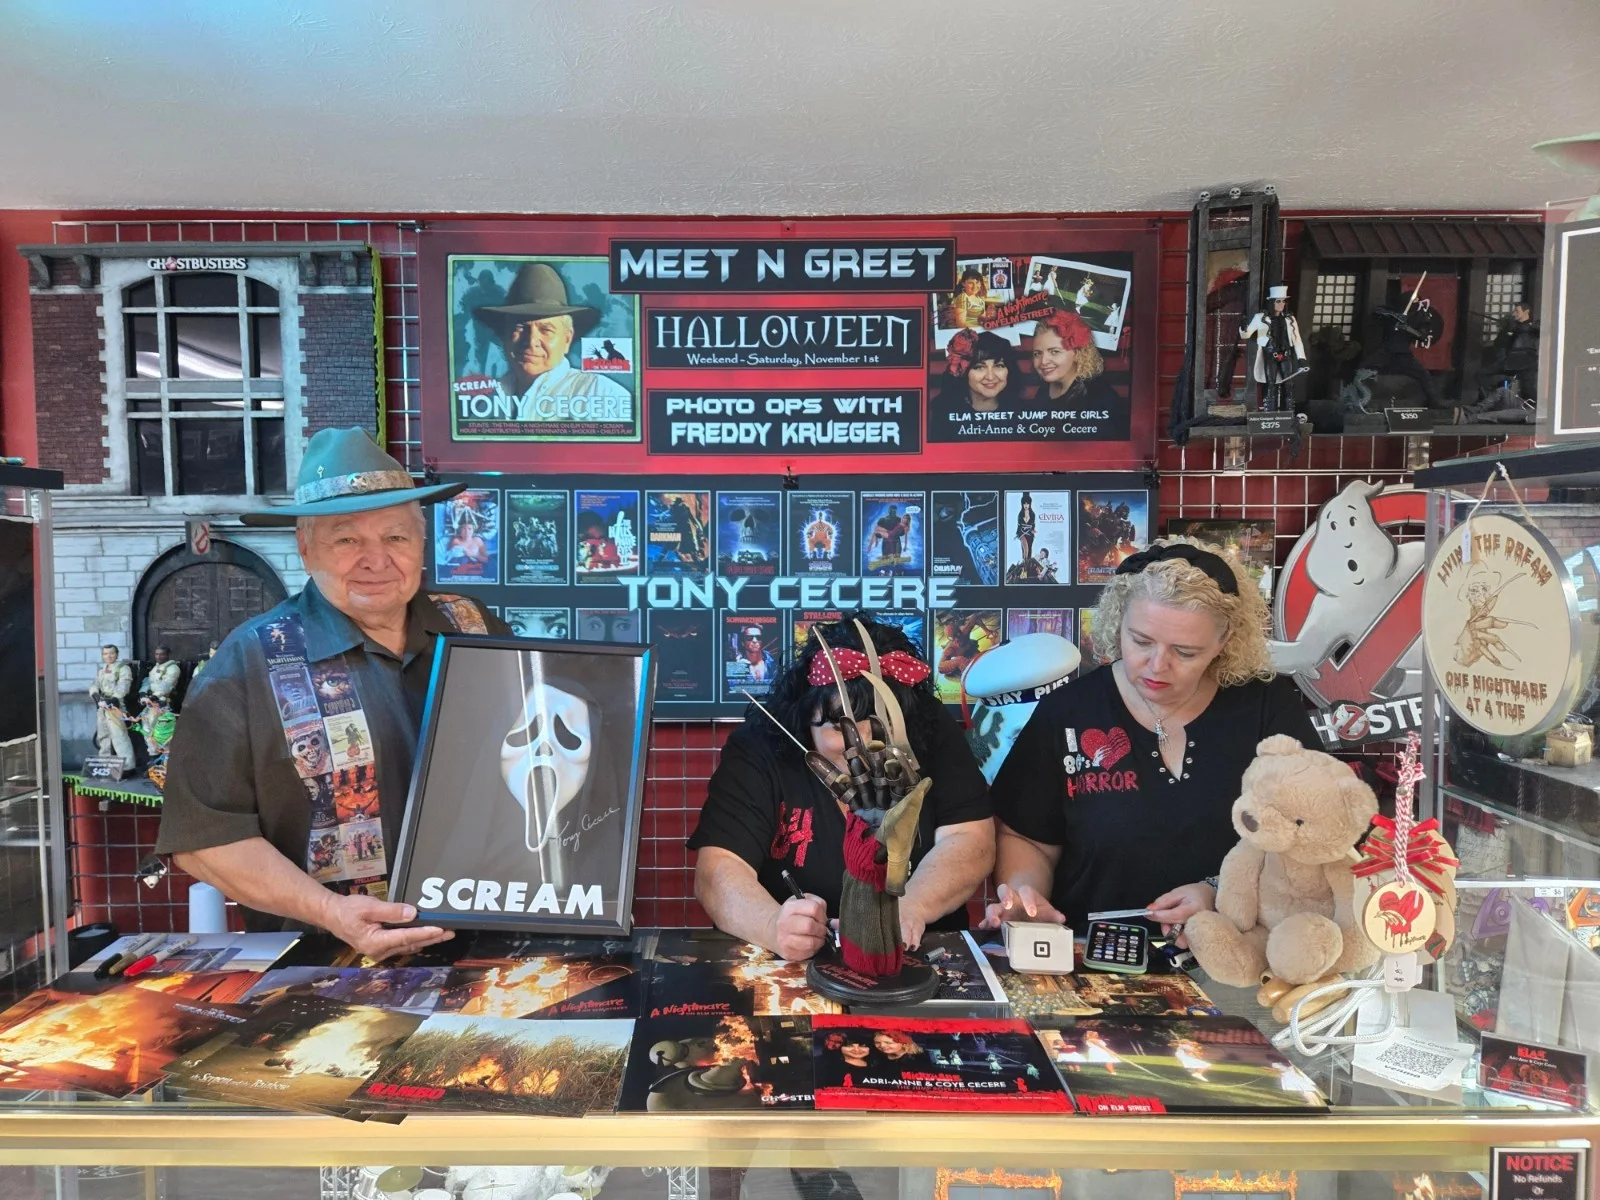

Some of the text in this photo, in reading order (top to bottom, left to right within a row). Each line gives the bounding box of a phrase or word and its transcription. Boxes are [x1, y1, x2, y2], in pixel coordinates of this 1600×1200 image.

[620, 247, 946, 283] MEET N GREET
[1020, 307, 1055, 320] STREET
[654, 315, 912, 354] HALLOWEEN
[804, 353, 861, 365] November
[863, 355, 879, 364] 1st
[453, 379, 496, 392] SCREAM
[458, 394, 632, 418] TONY CECERE
[666, 395, 902, 416] PHOTO OPS WITH
[949, 410, 1109, 421] ELM STREET JUMP ROPE GIRLS
[1400, 412, 1419, 420] $350
[671, 419, 900, 446] FREDDY KRUEGER
[957, 422, 1098, 437] Adri-Anne & Coye Cecere
[1260, 421, 1280, 429] $375
[650, 532, 681, 542] DARKMAN
[1474, 533, 1500, 556] THE
[1504, 536, 1552, 586] DREAM
[617, 572, 958, 613] TONY CECERE
[803, 611, 842, 619] STALLONE
[1445, 671, 1547, 706] ONE NIGHTMARE
[986, 690, 1022, 706] STAY
[1466, 697, 1481, 720] AT
[1485, 700, 1493, 719] A
[1496, 701, 1525, 726] TIME
[1065, 728, 1078, 752] I
[1067, 771, 1139, 800] HORROR
[417, 877, 604, 920] SCREAM
[650, 1002, 730, 1018] A Nightmare
[862, 1077, 921, 1087] ADRI-ANNE
[366, 1082, 446, 1100] RAMBO
[1127, 1104, 1151, 1112] STREET
[1506, 1154, 1574, 1171] NOTICE
[1513, 1173, 1563, 1183] No Refunds
